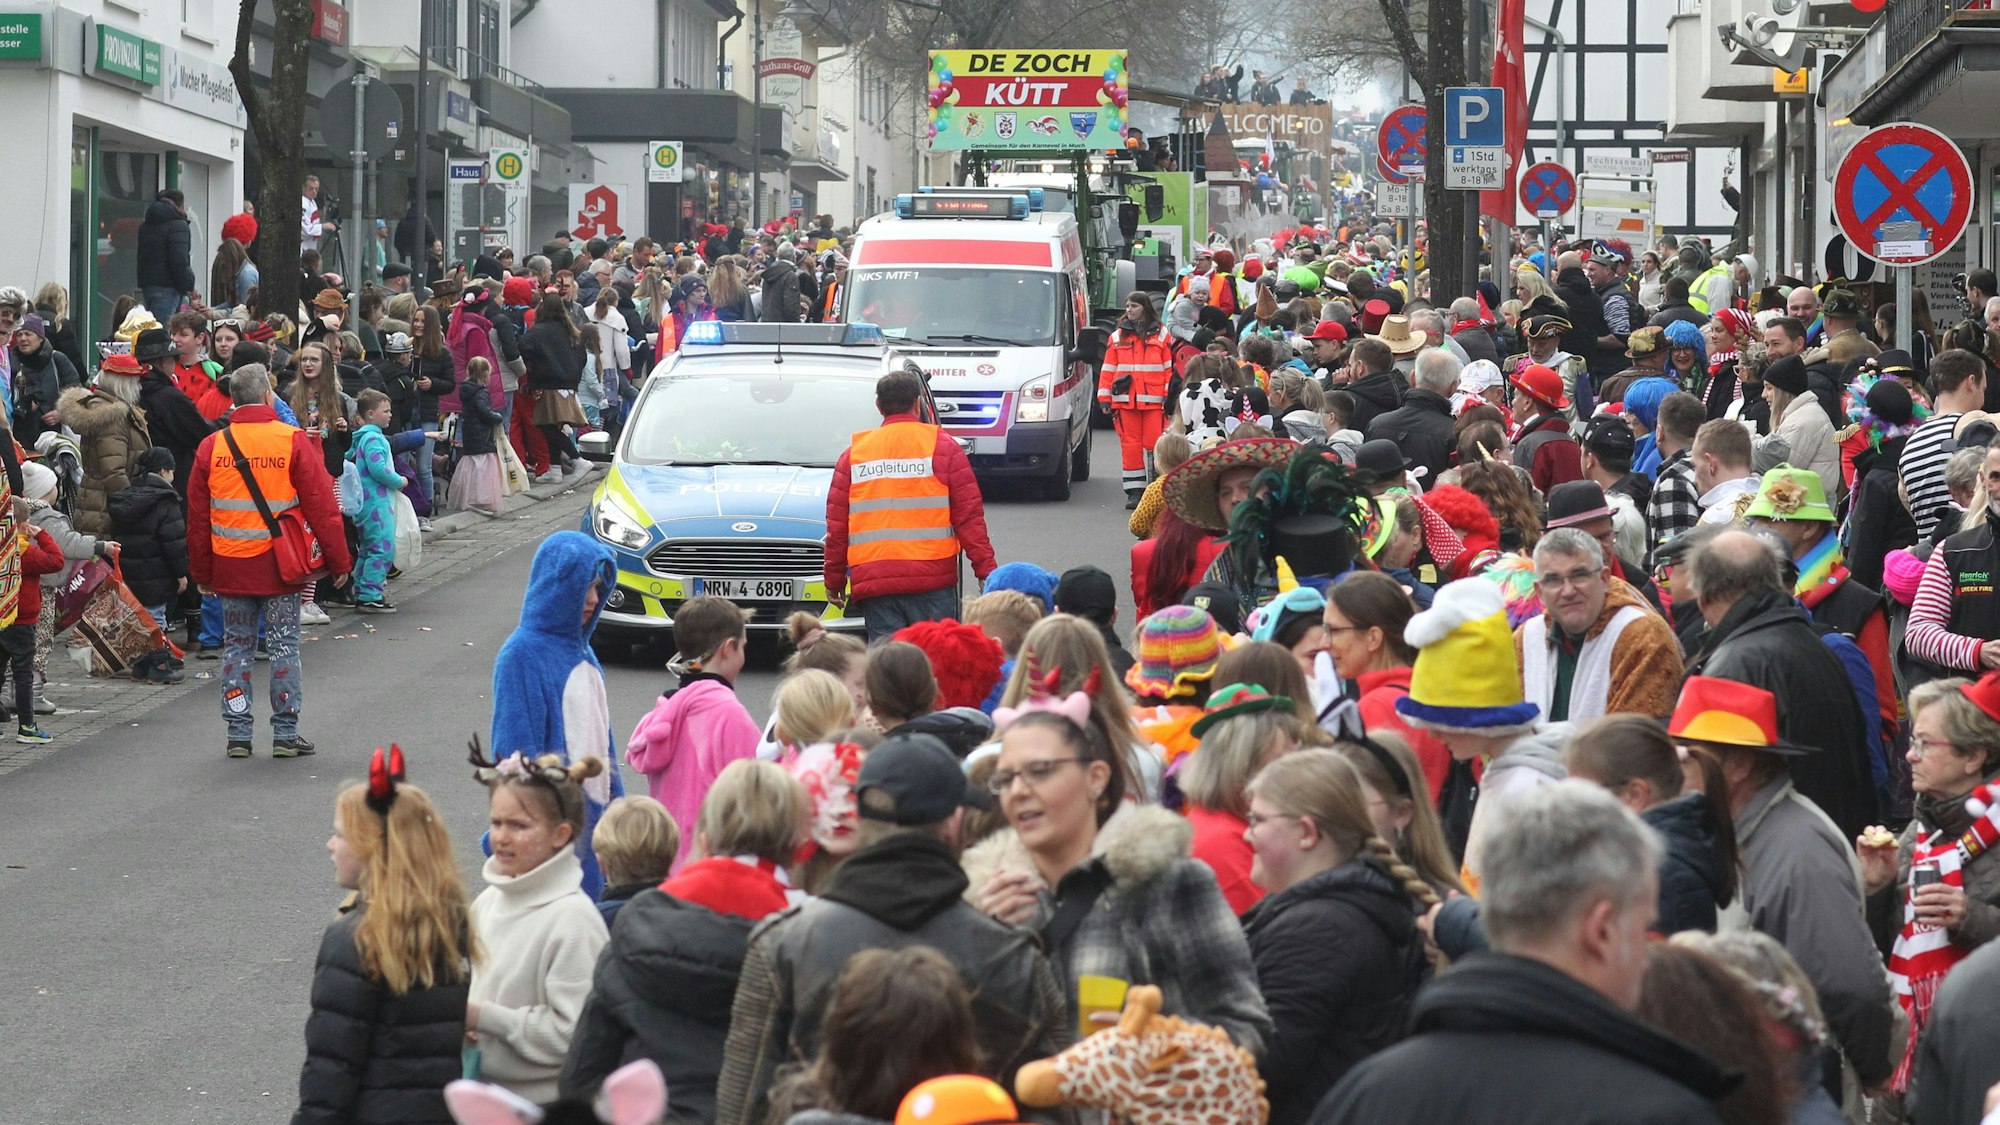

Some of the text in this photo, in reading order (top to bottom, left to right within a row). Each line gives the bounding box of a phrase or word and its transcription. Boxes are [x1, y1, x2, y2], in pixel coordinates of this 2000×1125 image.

[0, 24, 29, 34] stelle
[104, 33, 141, 71] PROVINZIAL
[968, 53, 1091, 73] DE ZOCH
[180, 65, 200, 92] Mucher
[201, 73, 233, 104] Pflegedienst
[984, 76, 1069, 105] KÜTT
[1459, 96, 1490, 139] P
[1202, 113, 1323, 135] ELCOME TO
[661, 150, 671, 163] H
[1587, 156, 1651, 167] Rechtsanwalt
[503, 158, 516, 174] H
[1452, 164, 1498, 175] werktags
[455, 167, 480, 177] Haus
[1460, 175, 1489, 185] 8-18 h
[1387, 185, 1409, 194] Mo-F
[1389, 195, 1407, 203] 8-18
[1381, 205, 1392, 213] Sa
[1395, 205, 1409, 214] 8-1
[1931, 261, 1965, 269] Unterha
[857, 271, 883, 282] NKS
[885, 271, 912, 280] MTF
[1931, 282, 1953, 290] Elek
[1931, 292, 1956, 300] Verka
[1933, 319, 1953, 330] el.:
[215, 457, 285, 469] ZUITUNG
[859, 461, 925, 477] Zugleitung
[679, 481, 823, 497] POLIZEI
[703, 580, 791, 597] NRW 4-6890
